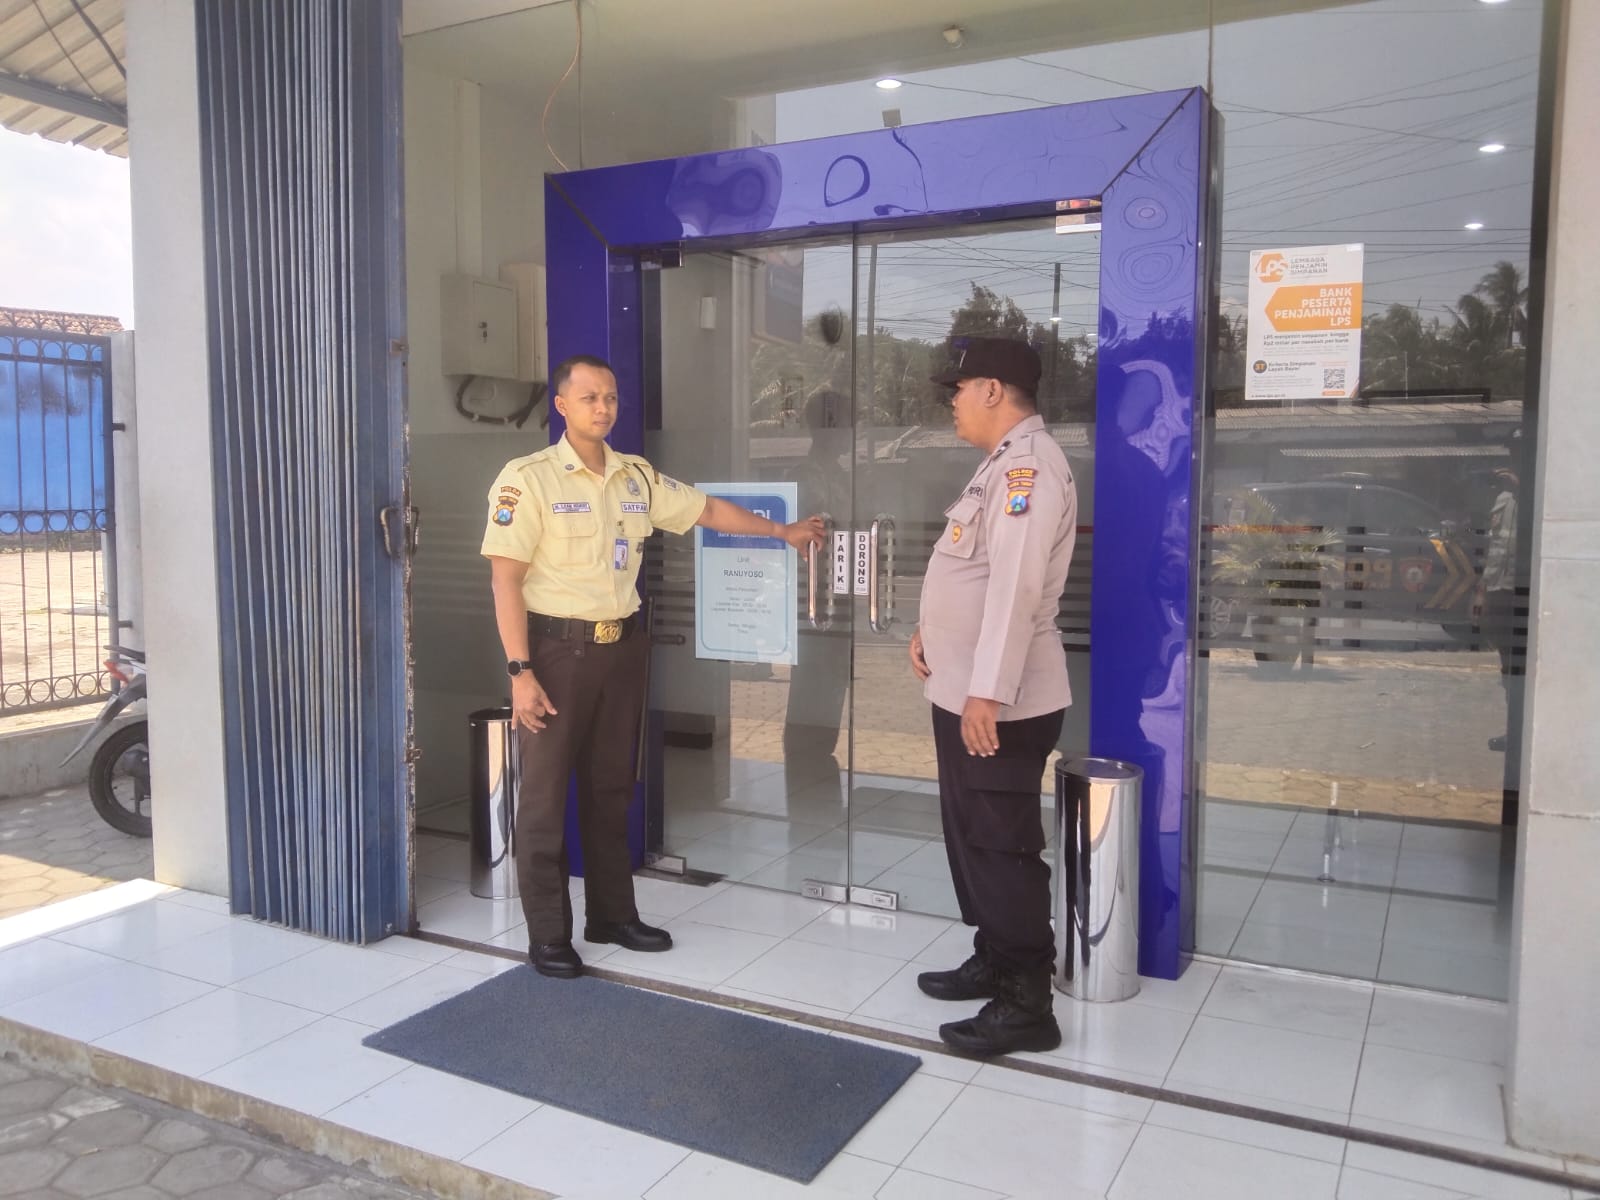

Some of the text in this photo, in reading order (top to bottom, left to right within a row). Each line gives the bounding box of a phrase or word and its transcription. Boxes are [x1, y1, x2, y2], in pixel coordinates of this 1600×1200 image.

[1319, 287, 1352, 298] BANK
[1302, 297, 1352, 308] PESERTA
[1274, 307, 1351, 319] PENJAMINAN
[1330, 316, 1351, 326] LPS
[837, 534, 845, 583] TARIK
[857, 535, 866, 585] DORONG
[723, 569, 764, 578] RANUYOSO
